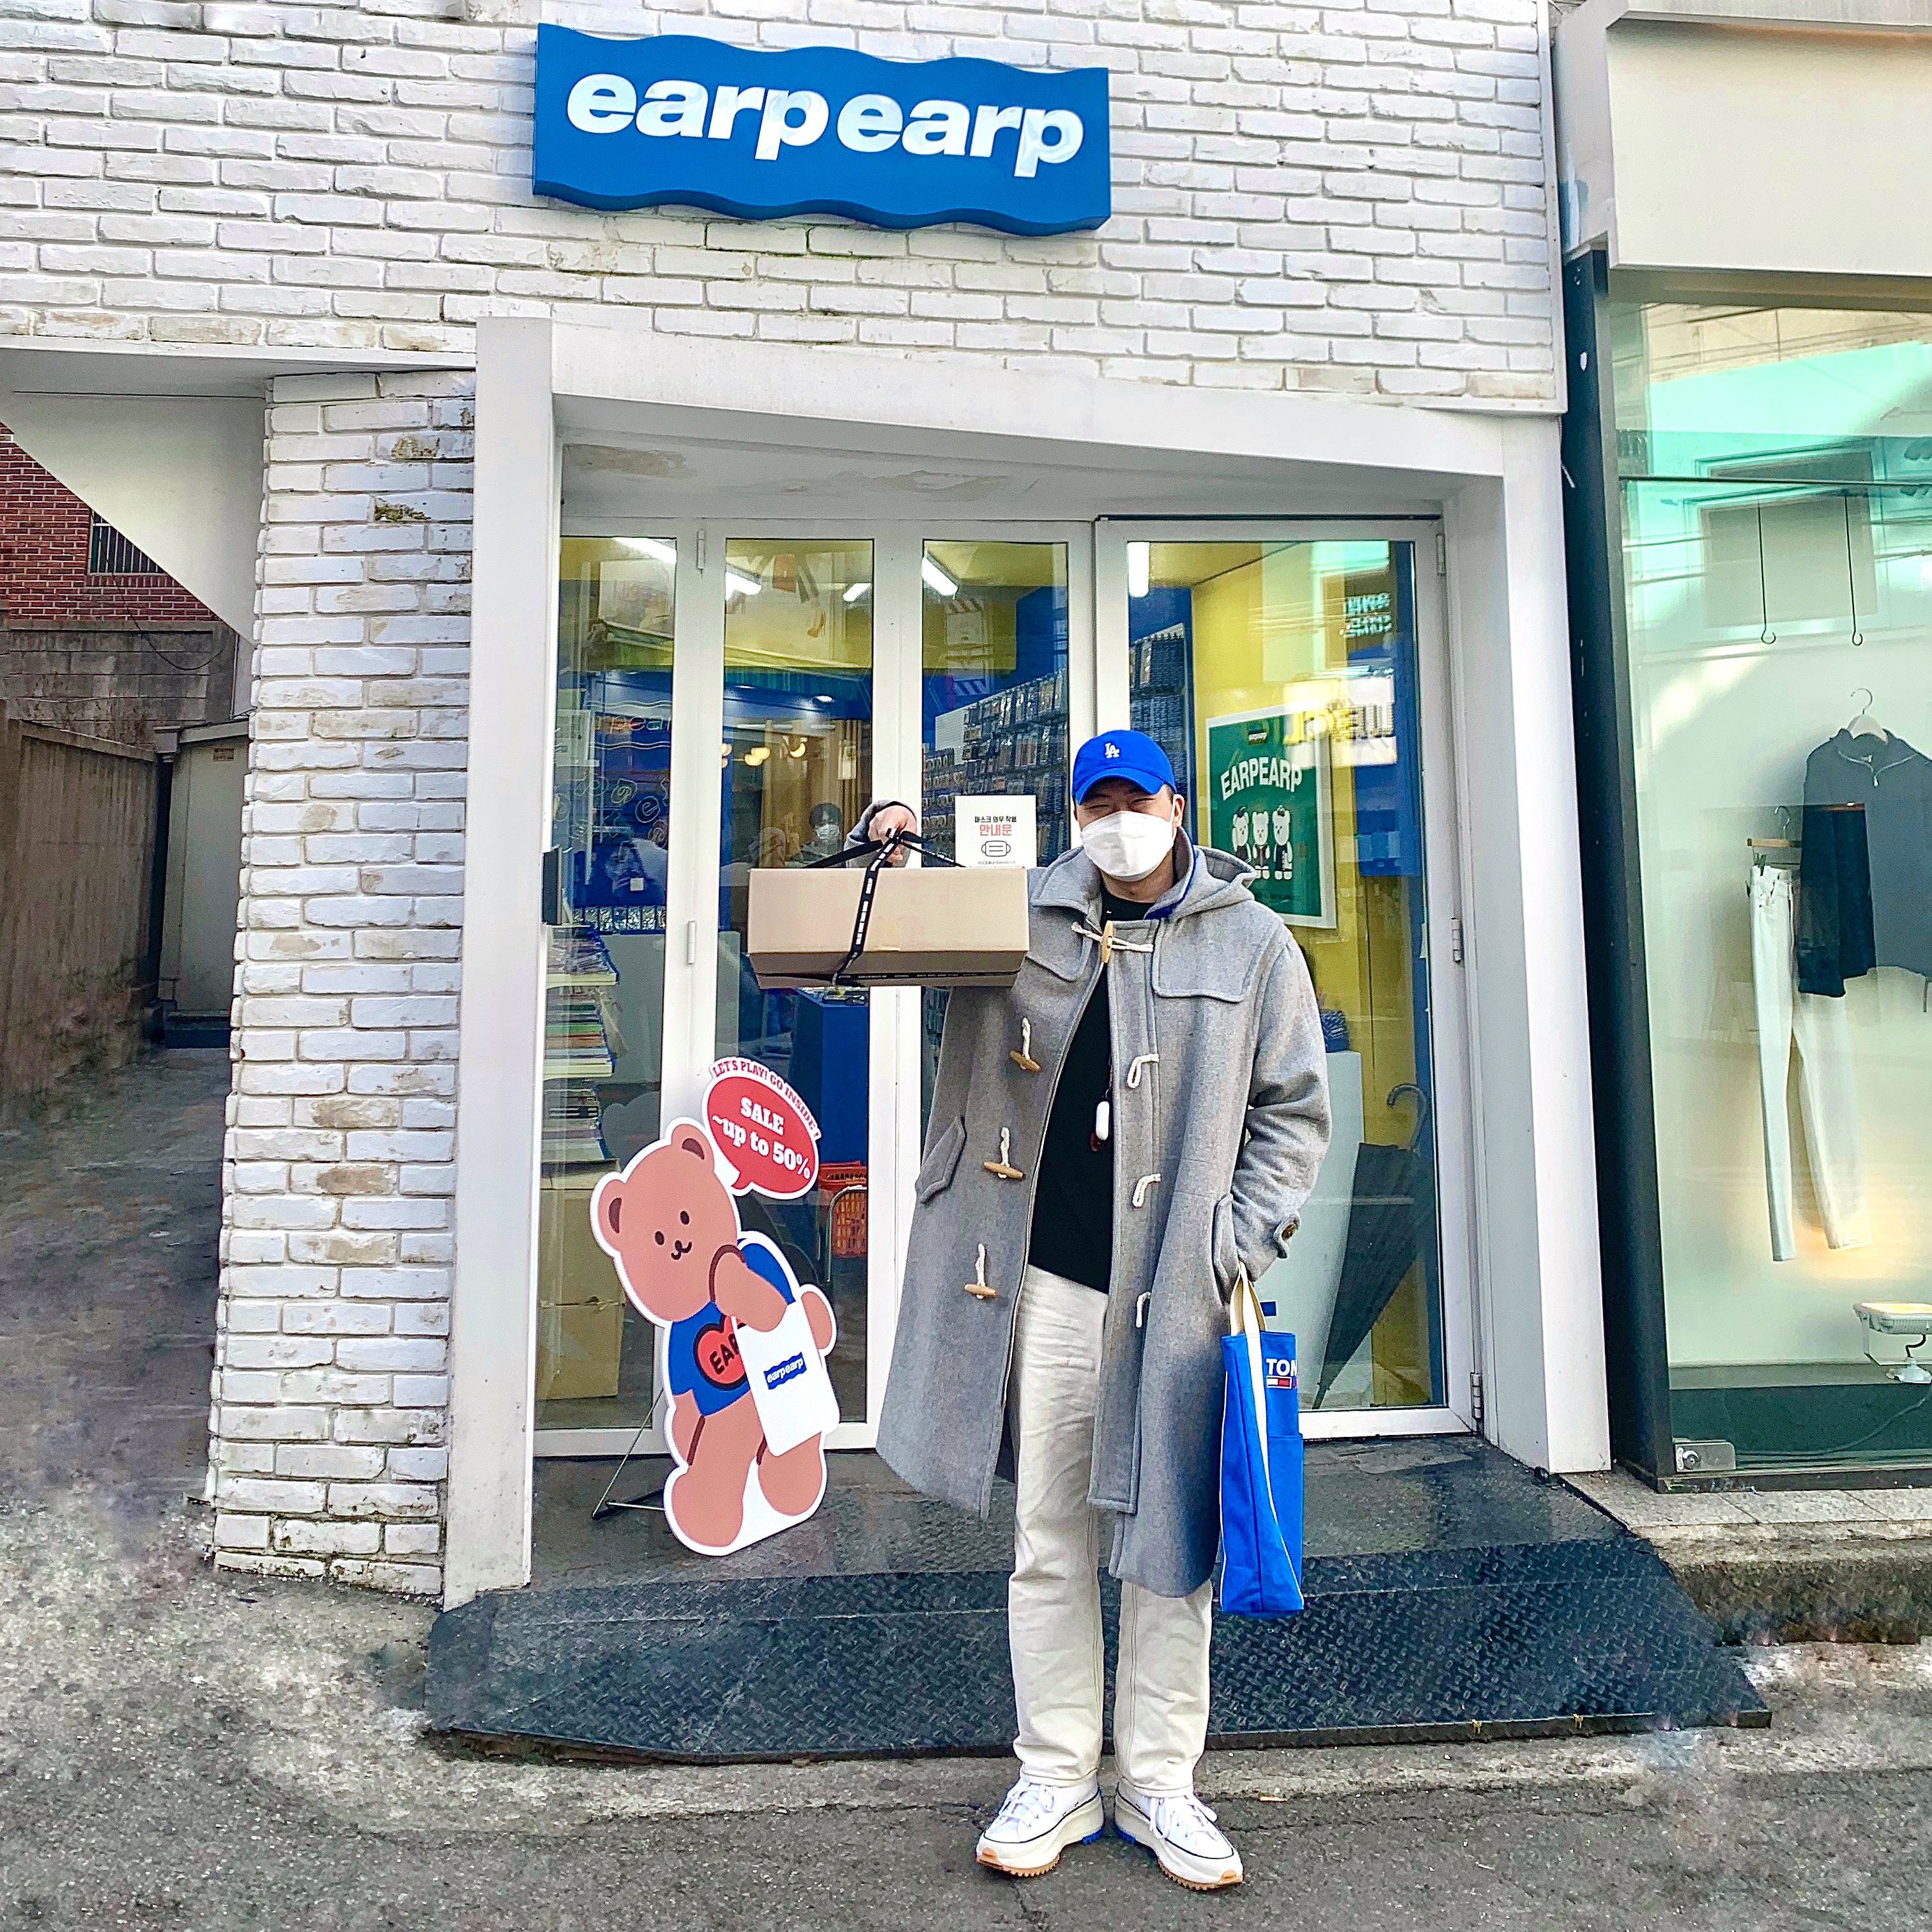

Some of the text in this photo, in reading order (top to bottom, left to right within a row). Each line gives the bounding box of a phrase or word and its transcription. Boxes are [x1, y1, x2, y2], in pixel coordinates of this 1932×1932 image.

[1105, 742, 1120, 758] LA
[1220, 756, 1303, 801] EARPEARP
[979, 824, 1012, 836] 안내문
[712, 1060, 738, 1078] LET'S
[770, 1075, 783, 1091] GO
[740, 1096, 784, 1136] SALE
[750, 1130, 769, 1156] to
[772, 1140, 811, 1179] 50%
